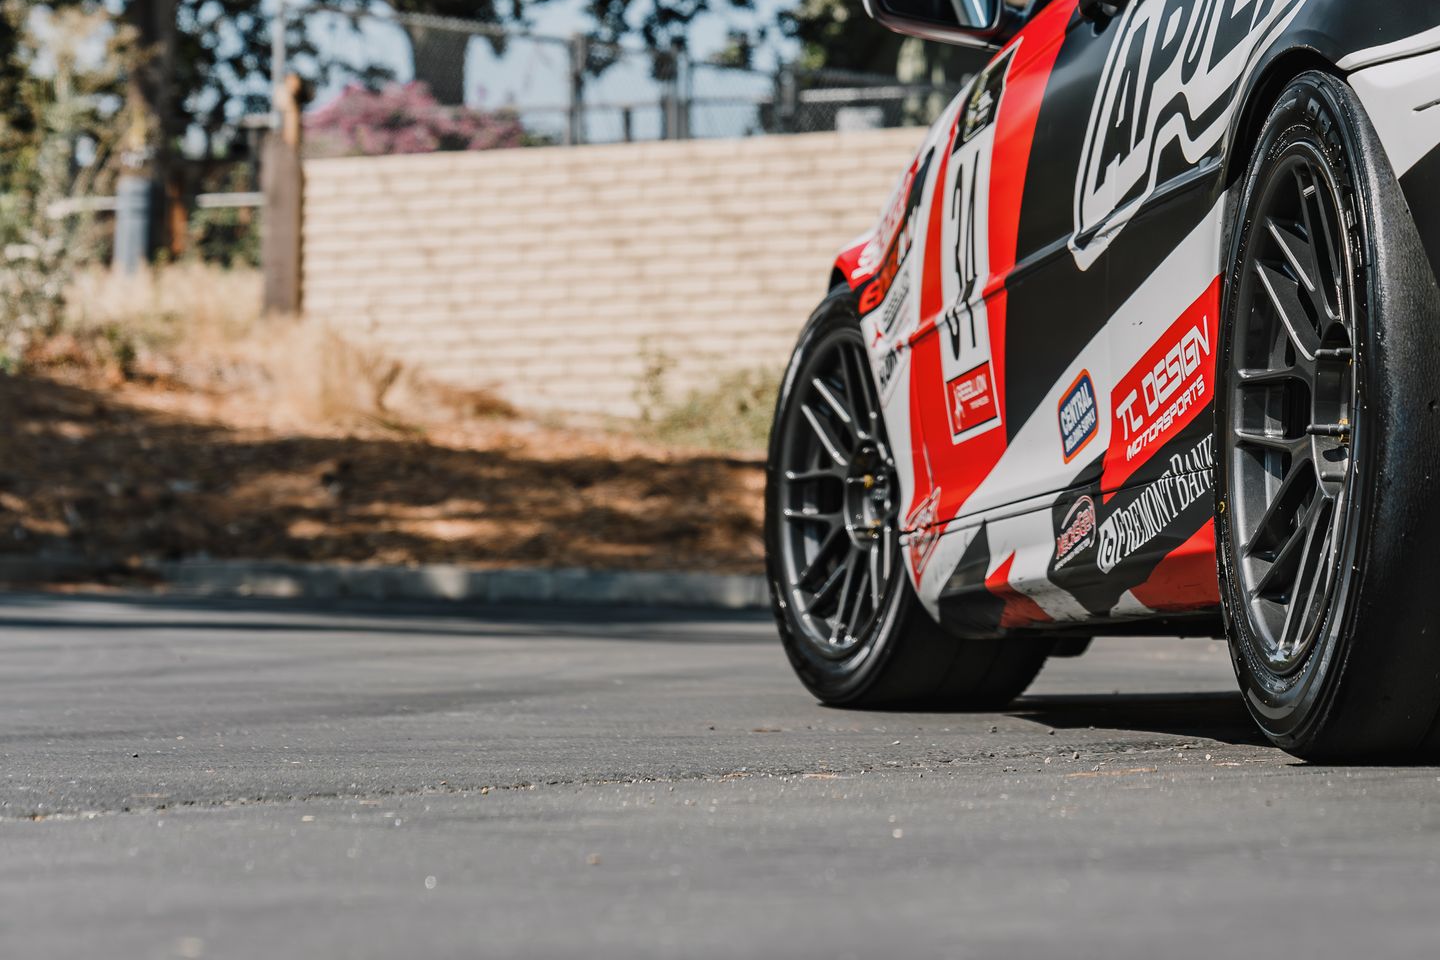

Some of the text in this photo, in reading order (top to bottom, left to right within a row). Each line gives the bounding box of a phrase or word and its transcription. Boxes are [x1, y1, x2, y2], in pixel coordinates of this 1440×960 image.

[1060, 382, 1093, 436] CENTRAL
[1115, 316, 1211, 441] TC DESIGN
[1126, 374, 1205, 462] MOTORSPORTS
